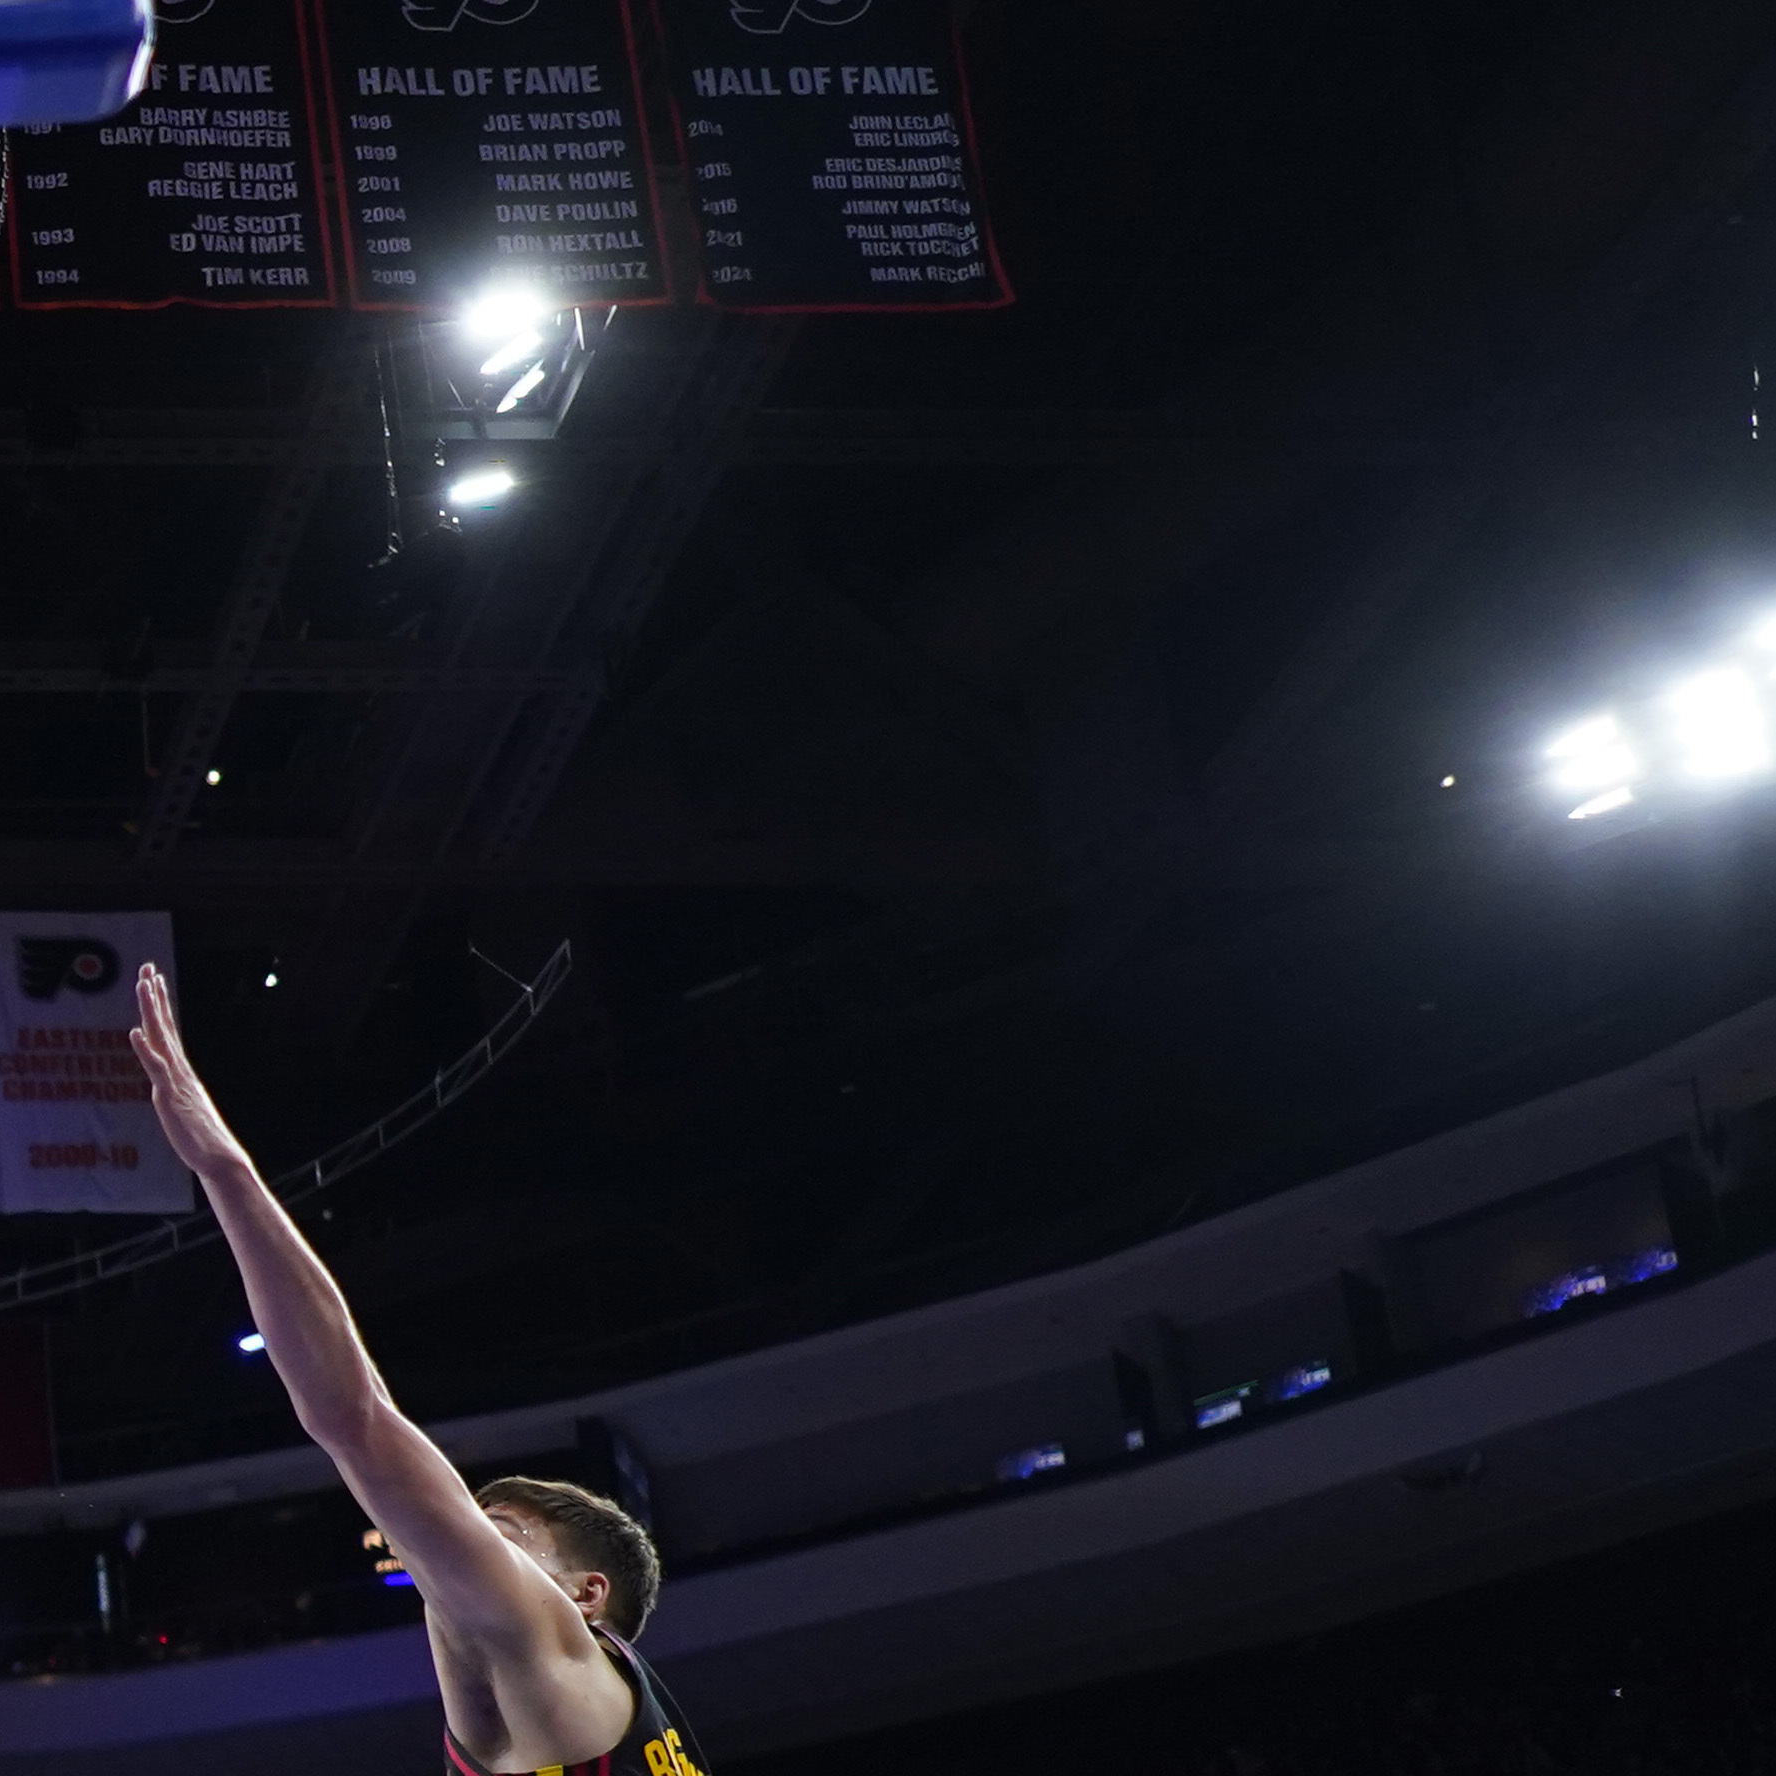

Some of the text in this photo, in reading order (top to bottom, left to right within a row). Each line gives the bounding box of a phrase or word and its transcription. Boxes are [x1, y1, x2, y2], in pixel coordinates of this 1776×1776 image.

[178, 64, 274, 94] FAME
[357, 64, 602, 98] HALL OF FAME
[692, 66, 939, 97] HALL OF FAME
[139, 107, 291, 129] BARRY ASHBEE
[482, 109, 622, 133] JOE WATSON
[848, 114, 893, 131] JOHN
[99, 126, 292, 148] GARY DORNHOEFER
[478, 144, 547, 162] BRIAN
[553, 140, 626, 161] PROPP
[26, 161, 297, 191] 1992 GENE HART
[357, 171, 634, 193] 2001 MARK HOWE
[147, 179, 298, 201] REGGIE LEACH
[496, 200, 638, 223] DAVE POULIN
[841, 200, 898, 215] JIMMY
[31, 213, 302, 246] 1993 JOE SCOTT
[169, 232, 306, 254] ED VAN IMPE
[497, 230, 645, 254] RON HEXTALL
[860, 241, 904, 257] RICK
[35, 266, 311, 287] 1994 TIM KERR
[870, 266, 923, 282] MARK
